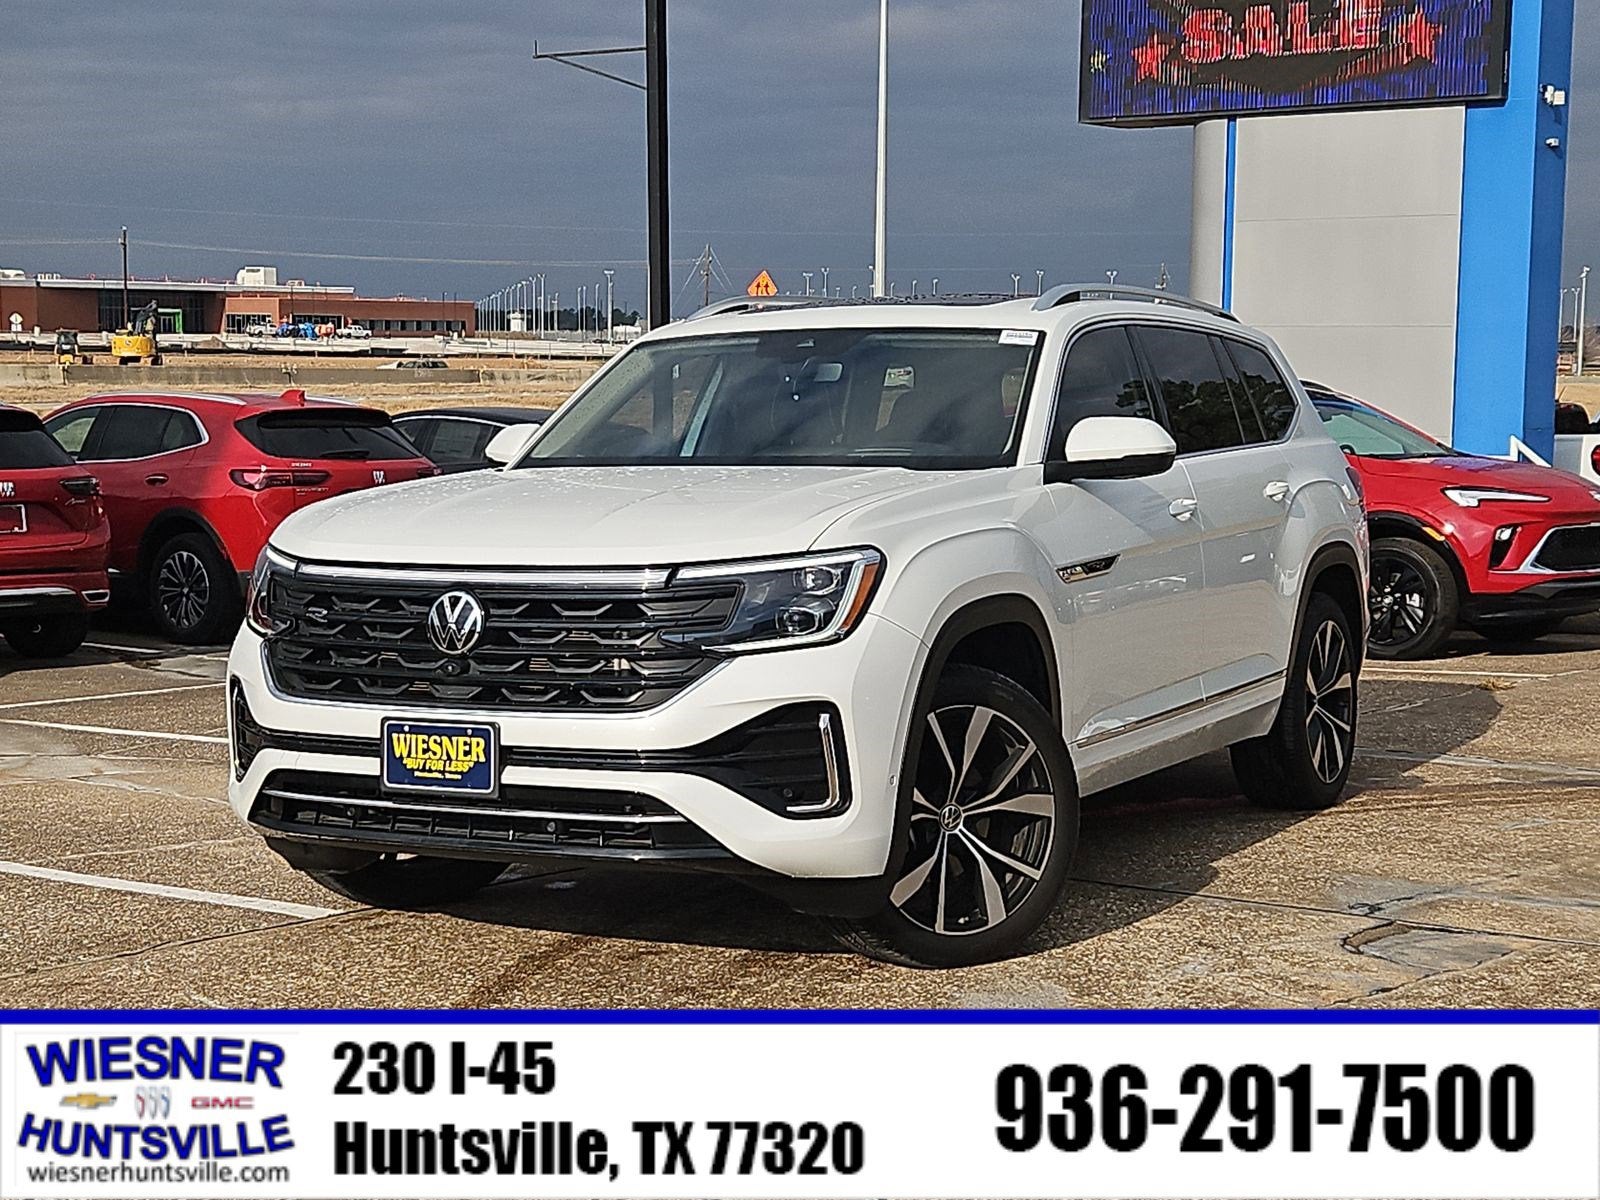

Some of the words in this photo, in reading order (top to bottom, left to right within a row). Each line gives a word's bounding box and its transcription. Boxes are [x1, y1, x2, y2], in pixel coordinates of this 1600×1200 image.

[1181, 0, 1382, 63] SALE
[391, 732, 486, 763] WIESNER
[425, 760, 444, 771] FOR
